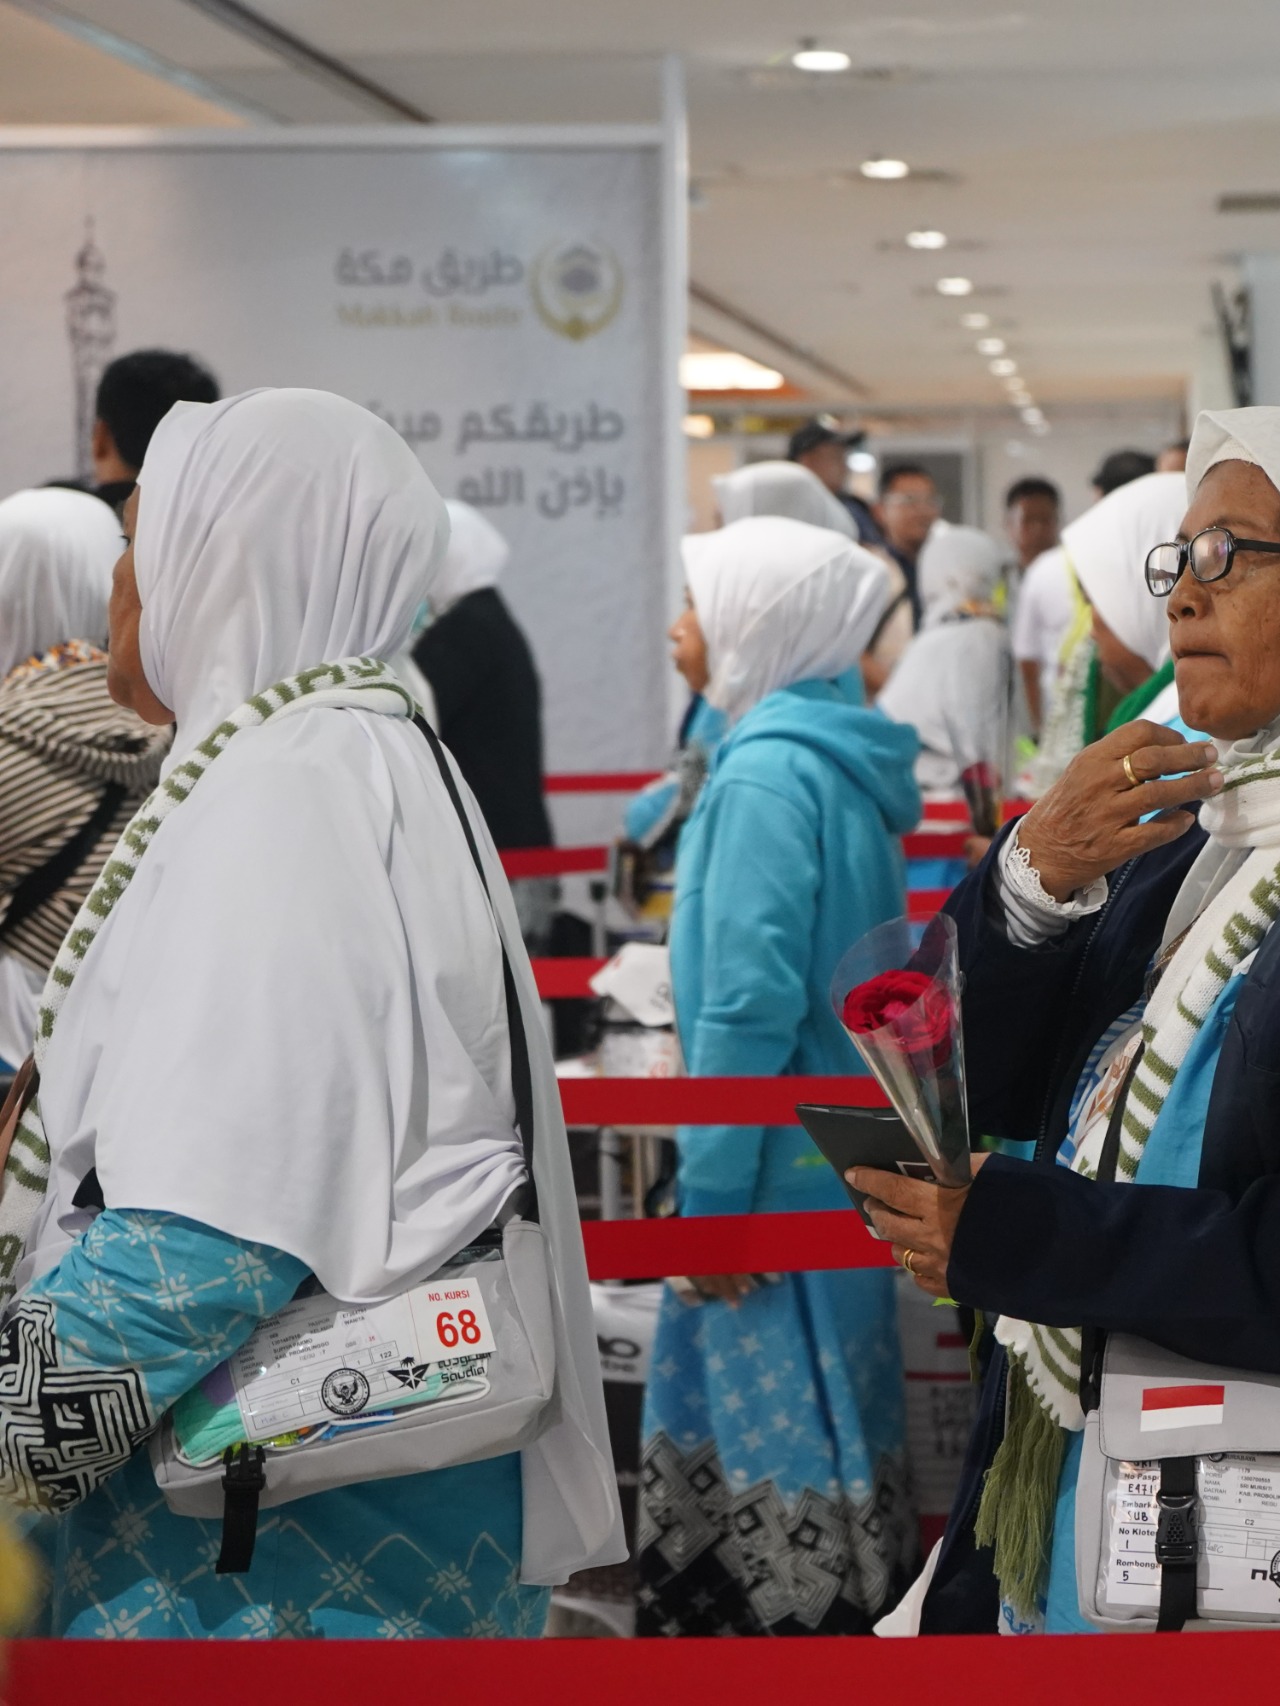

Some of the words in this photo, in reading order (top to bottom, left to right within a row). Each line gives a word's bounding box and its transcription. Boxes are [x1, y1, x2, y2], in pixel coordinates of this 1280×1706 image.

[334, 247, 414, 288] مكة
[420, 247, 524, 298] طريق
[454, 399, 625, 456] طريقكم
[456, 465, 525, 507] الله
[537, 465, 625, 520] بإذن
[428, 1293, 443, 1302] NO.
[444, 1290, 470, 1300] KURSI
[436, 1309, 482, 1348] 68
[379, 1350, 393, 1359] 122
[290, 1377, 300, 1385] C1
[1137, 1474, 1159, 1482] Pasp
[1128, 1483, 1153, 1495] E471
[1122, 1500, 1158, 1509] Embarka
[1128, 1510, 1149, 1522] SUB
[1245, 1518, 1255, 1526] C2
[1118, 1527, 1130, 1535] No
[1132, 1527, 1156, 1537] Klote
[1116, 1558, 1160, 1570] Rombonga
[1122, 1570, 1129, 1581] 5
